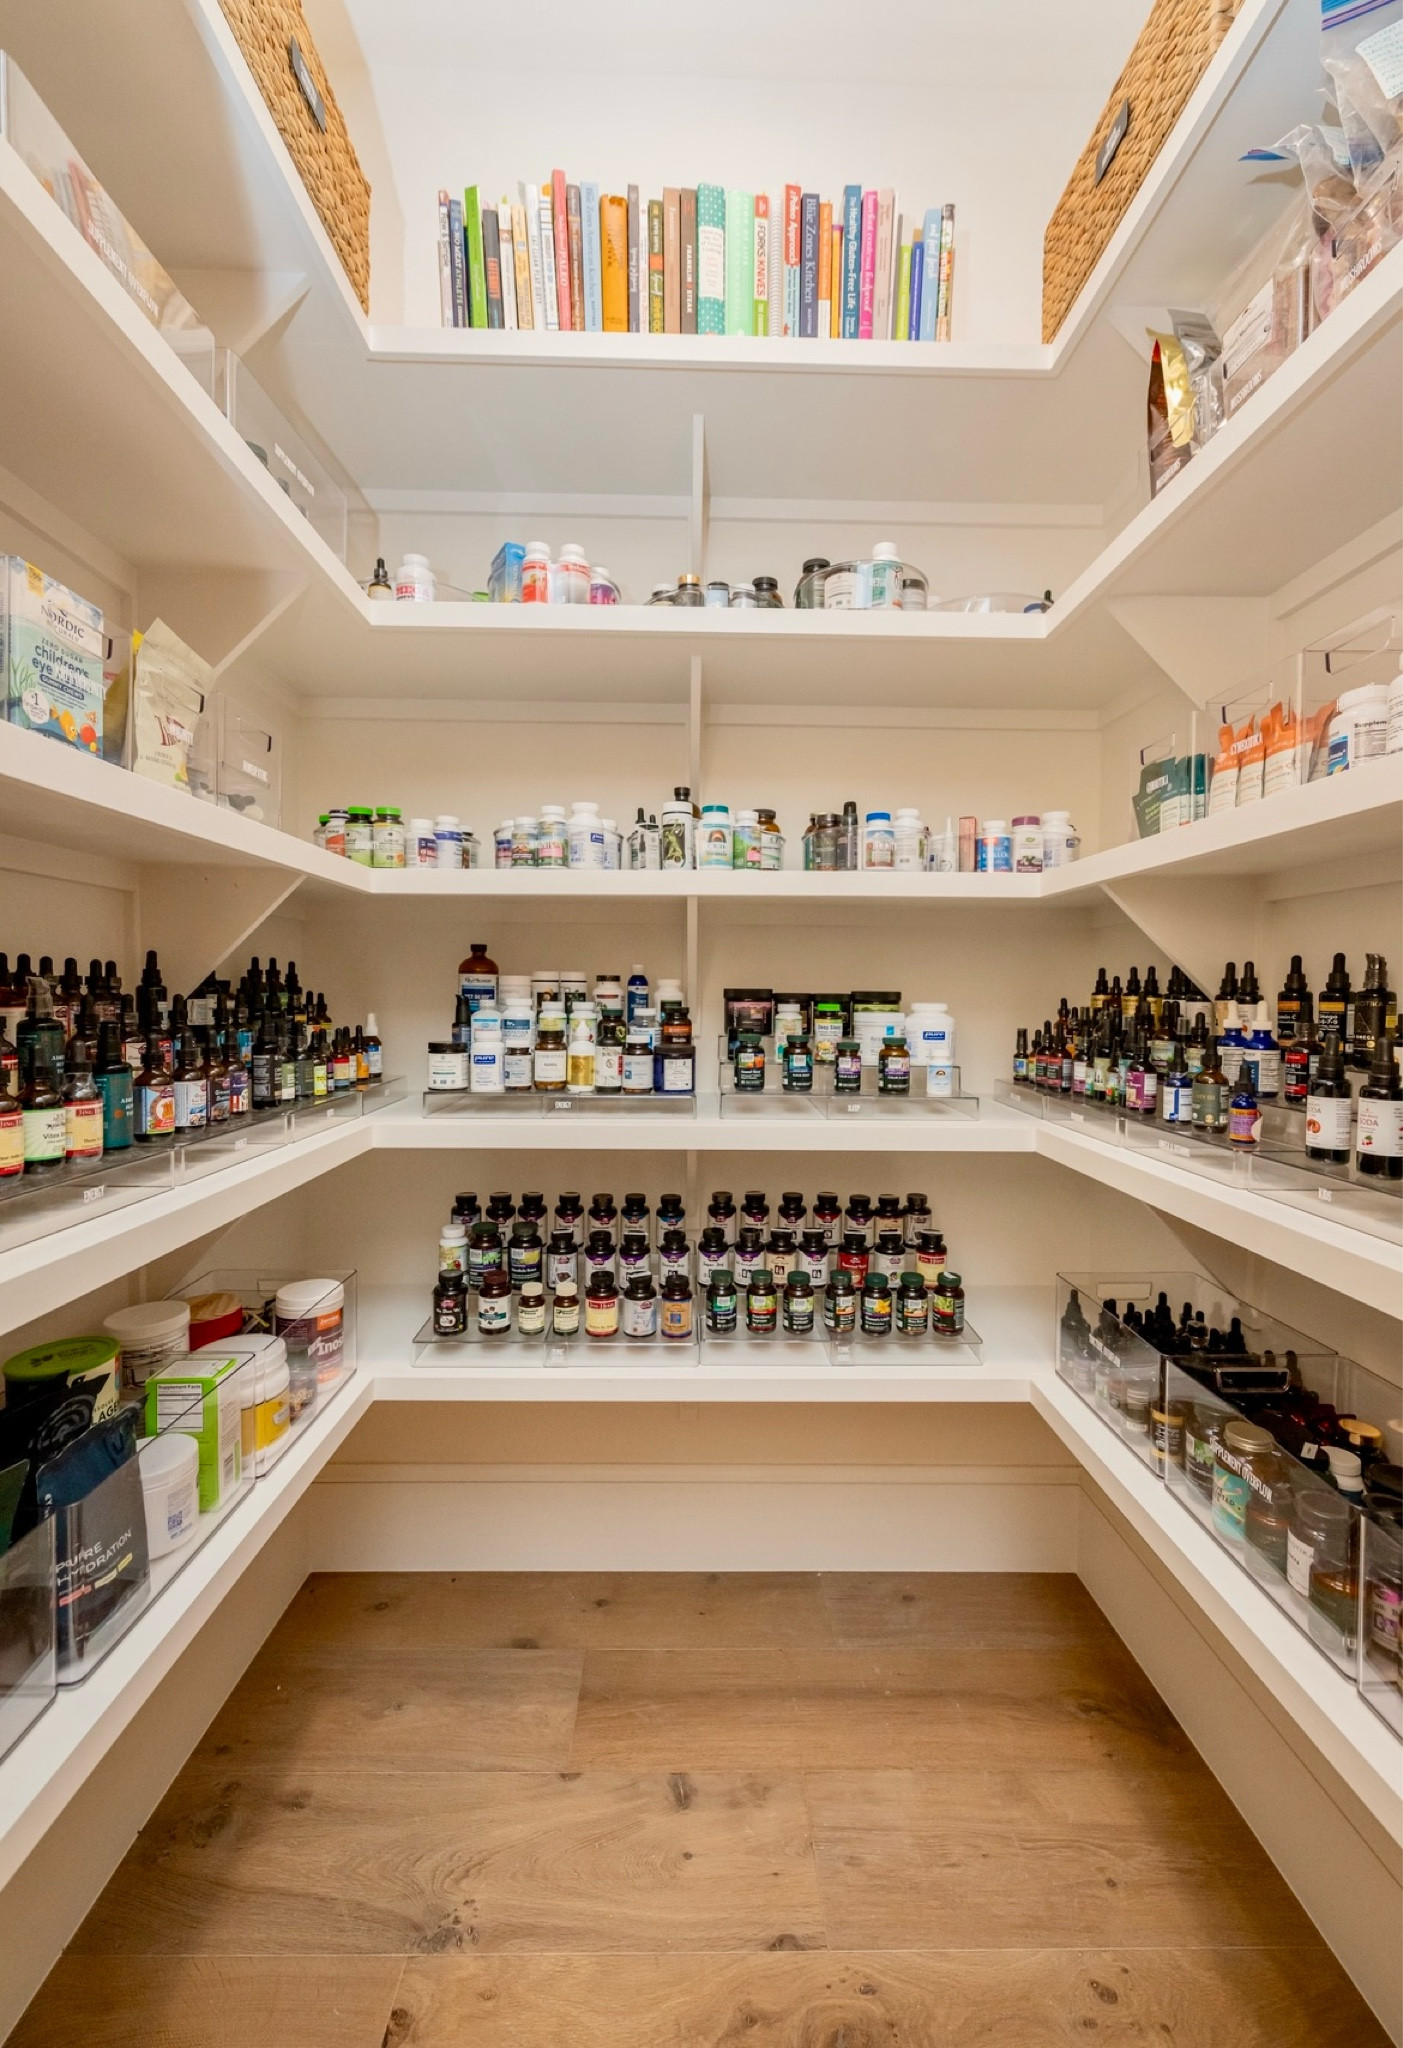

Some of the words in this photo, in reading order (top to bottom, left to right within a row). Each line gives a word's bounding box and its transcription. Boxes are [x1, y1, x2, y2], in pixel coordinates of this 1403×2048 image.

[789, 194, 798, 221] Paleo
[847, 207, 857, 240] Healthy
[441, 240, 450, 267] Simple
[453, 231, 460, 244] NO
[757, 225, 766, 257] FORKS
[787, 222, 797, 264] Approach
[805, 225, 816, 259] Zones
[558, 250, 568, 286] PALEO
[756, 259, 765, 296] KNIVES
[805, 260, 816, 303] Kitchen
[847, 241, 857, 291] Gluten-Free
[455, 269, 463, 304] ATHLETE
[847, 293, 856, 309] Life
[41, 604, 85, 639] NORDIC
[32, 657, 53, 676] eye
[35, 645, 90, 679] children's
[41, 637, 59, 651] ZERO
[61, 647, 84, 663] SUGAR
[1354, 720, 1387, 729] Supplem
[318, 1336, 344, 1357] Inos
[1209, 1435, 1242, 1475] SUPPLEMENT
[1241, 1463, 1273, 1504] OVERFLOW
[56, 1529, 133, 1587] HYDRATION
